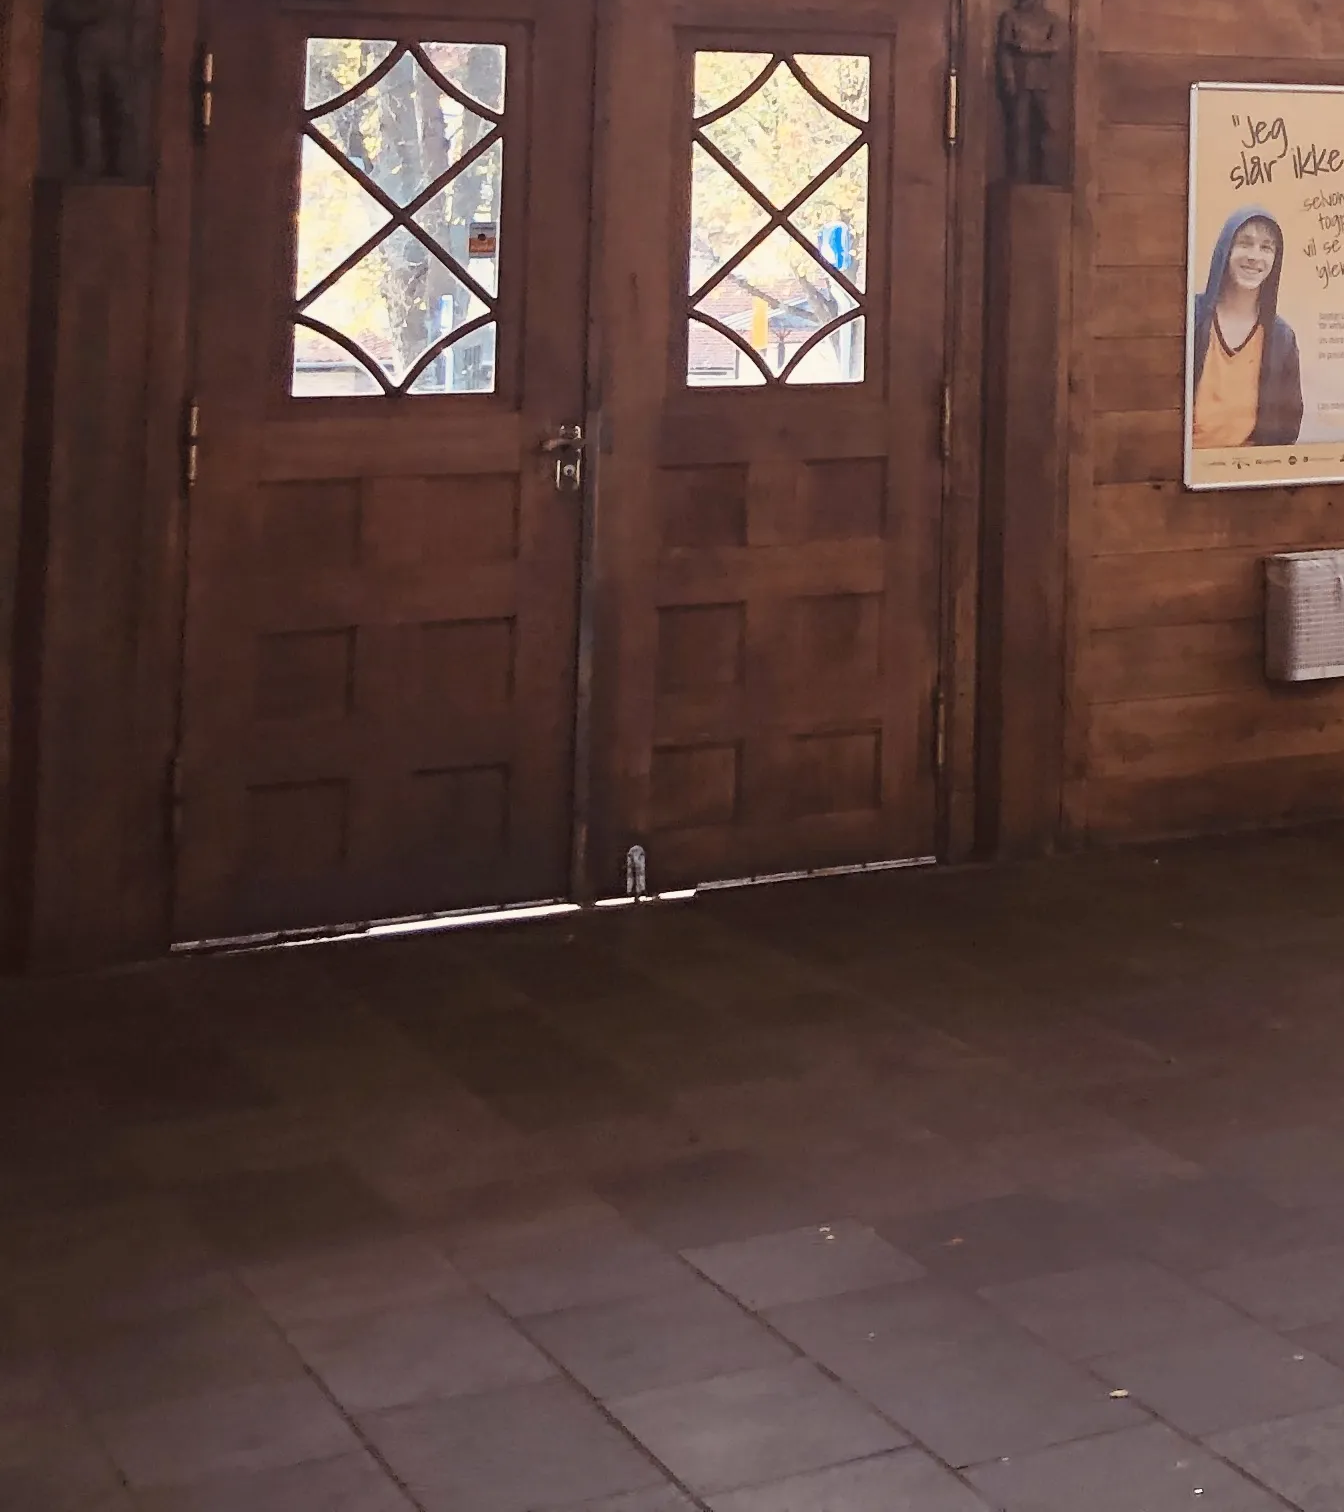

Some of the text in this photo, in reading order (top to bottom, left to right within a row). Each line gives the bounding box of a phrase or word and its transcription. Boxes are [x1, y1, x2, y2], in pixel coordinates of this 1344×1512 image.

[1229, 150, 1278, 190] slår
[1303, 237, 1317, 258] vil
[1322, 239, 1342, 254] se
